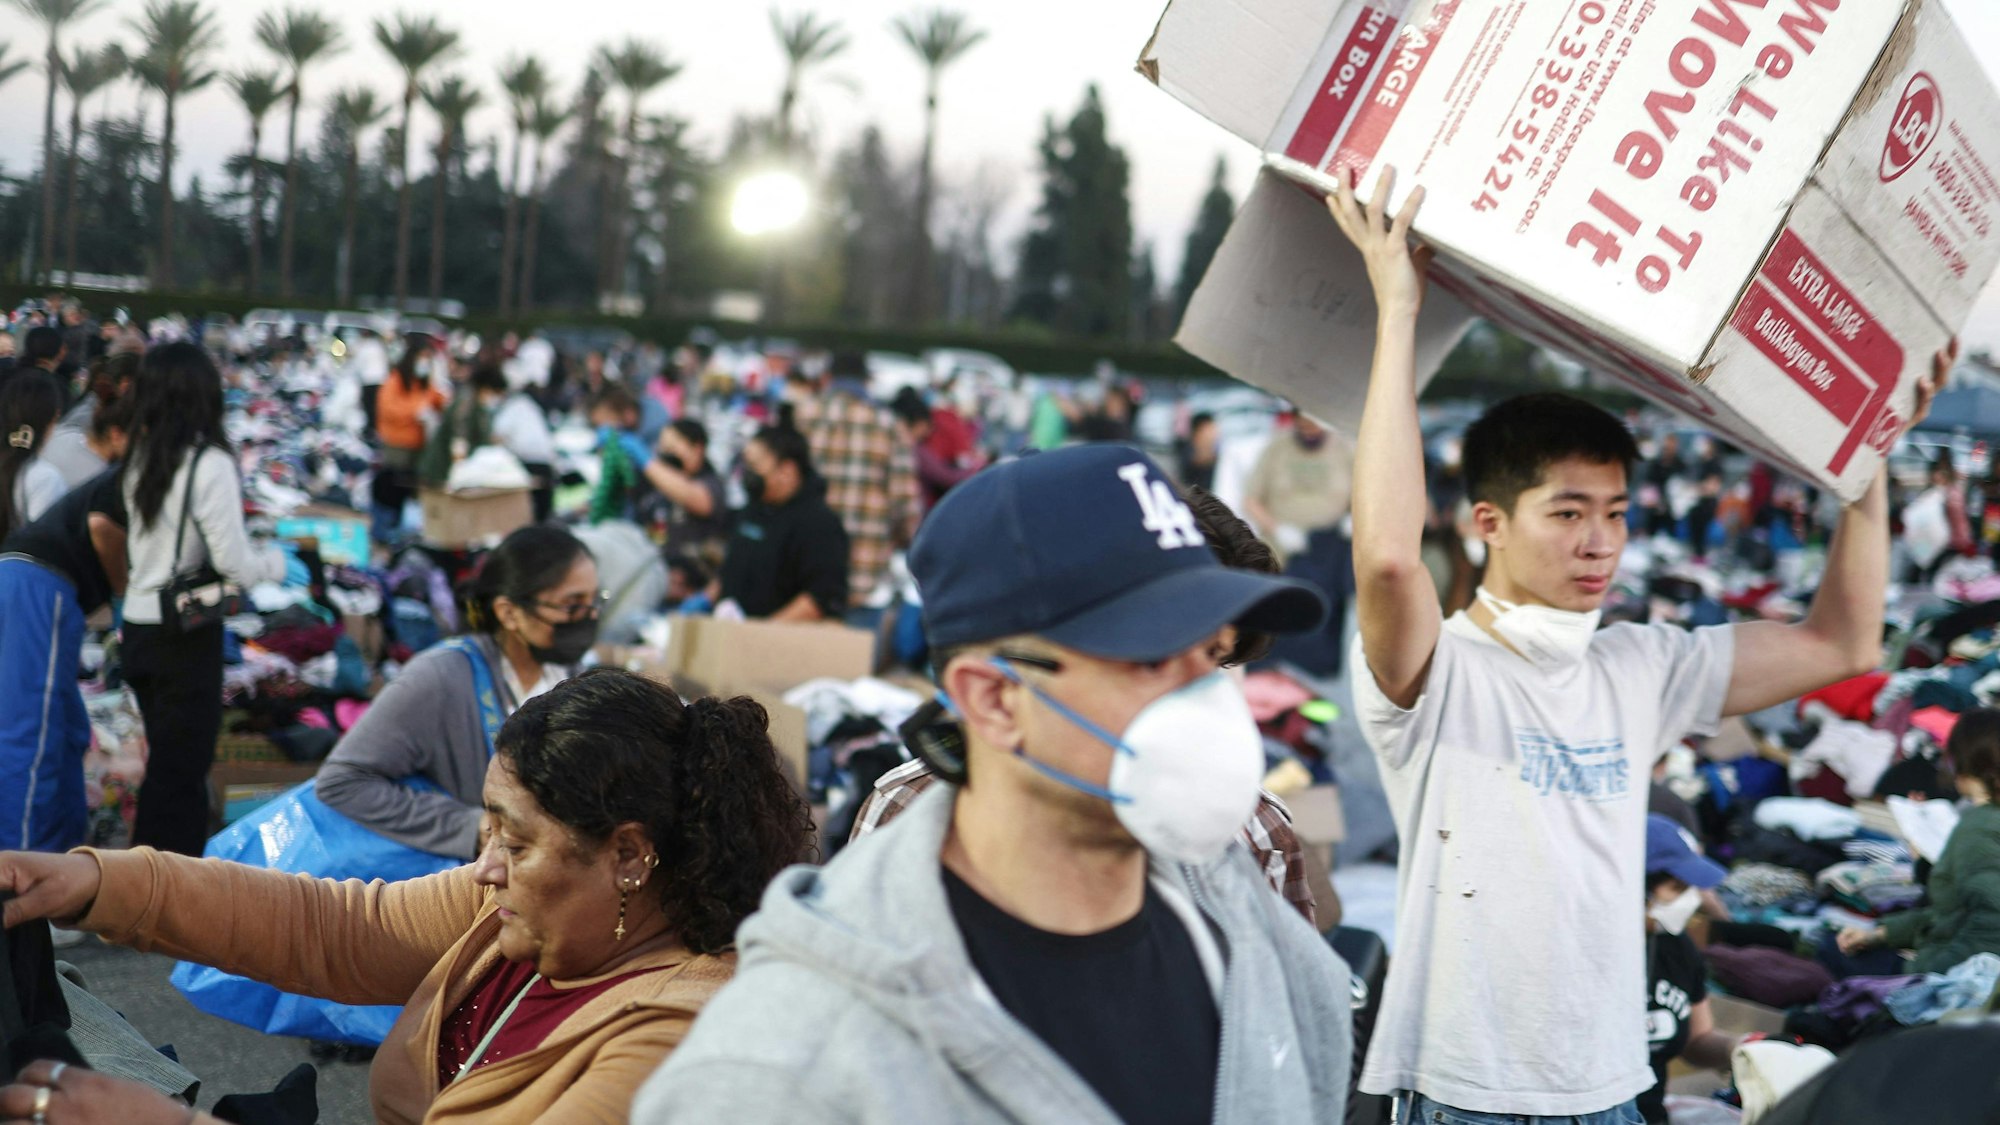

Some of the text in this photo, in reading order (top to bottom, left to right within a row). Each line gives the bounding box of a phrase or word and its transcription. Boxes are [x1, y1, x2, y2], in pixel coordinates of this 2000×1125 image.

[1328, 2, 1391, 100] an Box
[1574, 60, 1601, 91] USA
[1595, 28, 1614, 57] our
[1616, 37, 1633, 57] at
[1470, 1, 1606, 212] 0-338-5424
[1540, 94, 1581, 153] Hotline
[1613, 0, 1770, 180] Move
[1892, 99, 1929, 157] LBC
[1525, 156, 1542, 179] at:
[1635, 0, 1841, 294] We Like To
[1565, 187, 1643, 268] It
[1786, 255, 1867, 342] EXTRA LARGE
[1753, 307, 1838, 392] Balikbayan Box
[1117, 462, 1206, 550] LA
